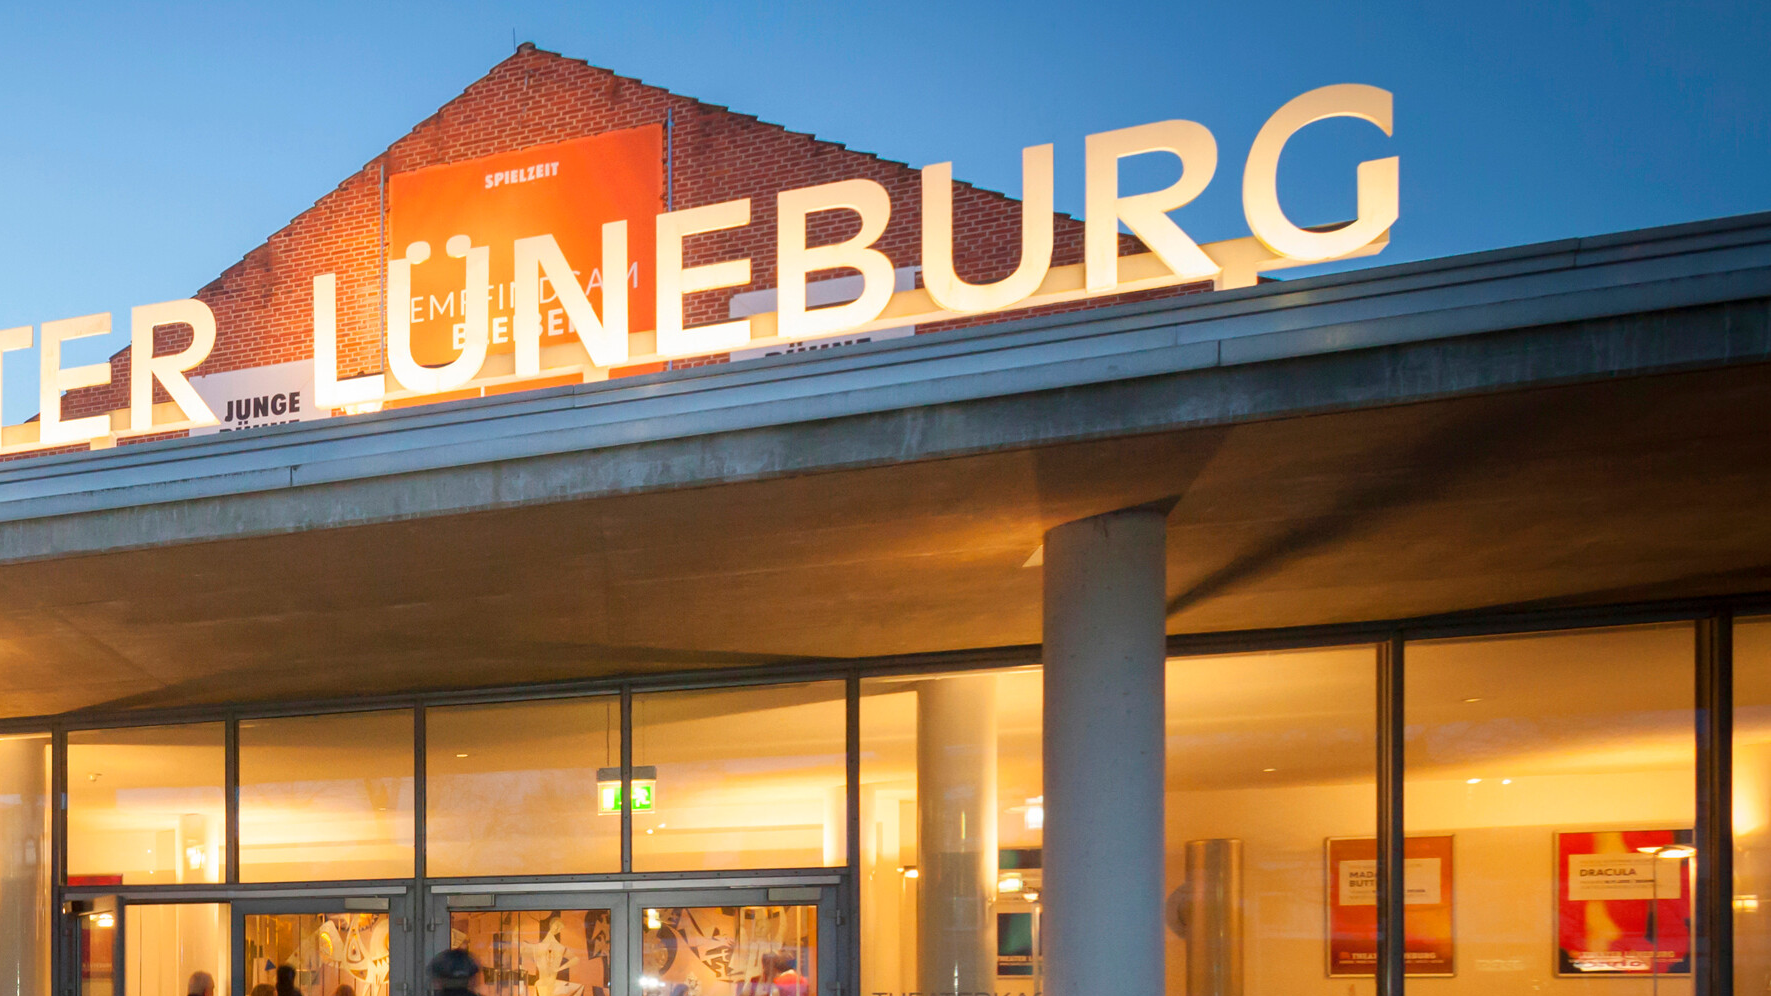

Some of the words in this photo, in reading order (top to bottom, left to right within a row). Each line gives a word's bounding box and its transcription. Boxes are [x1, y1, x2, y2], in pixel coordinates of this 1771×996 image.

[484, 161, 560, 190] SPIELZEIT
[312, 83, 1400, 410] LÜNEBURG
[410, 260, 638, 324] EMIDA
[224, 391, 301, 422] JUNGE
[1349, 871, 1377, 879] MAD
[1579, 868, 1637, 877] DRACULA
